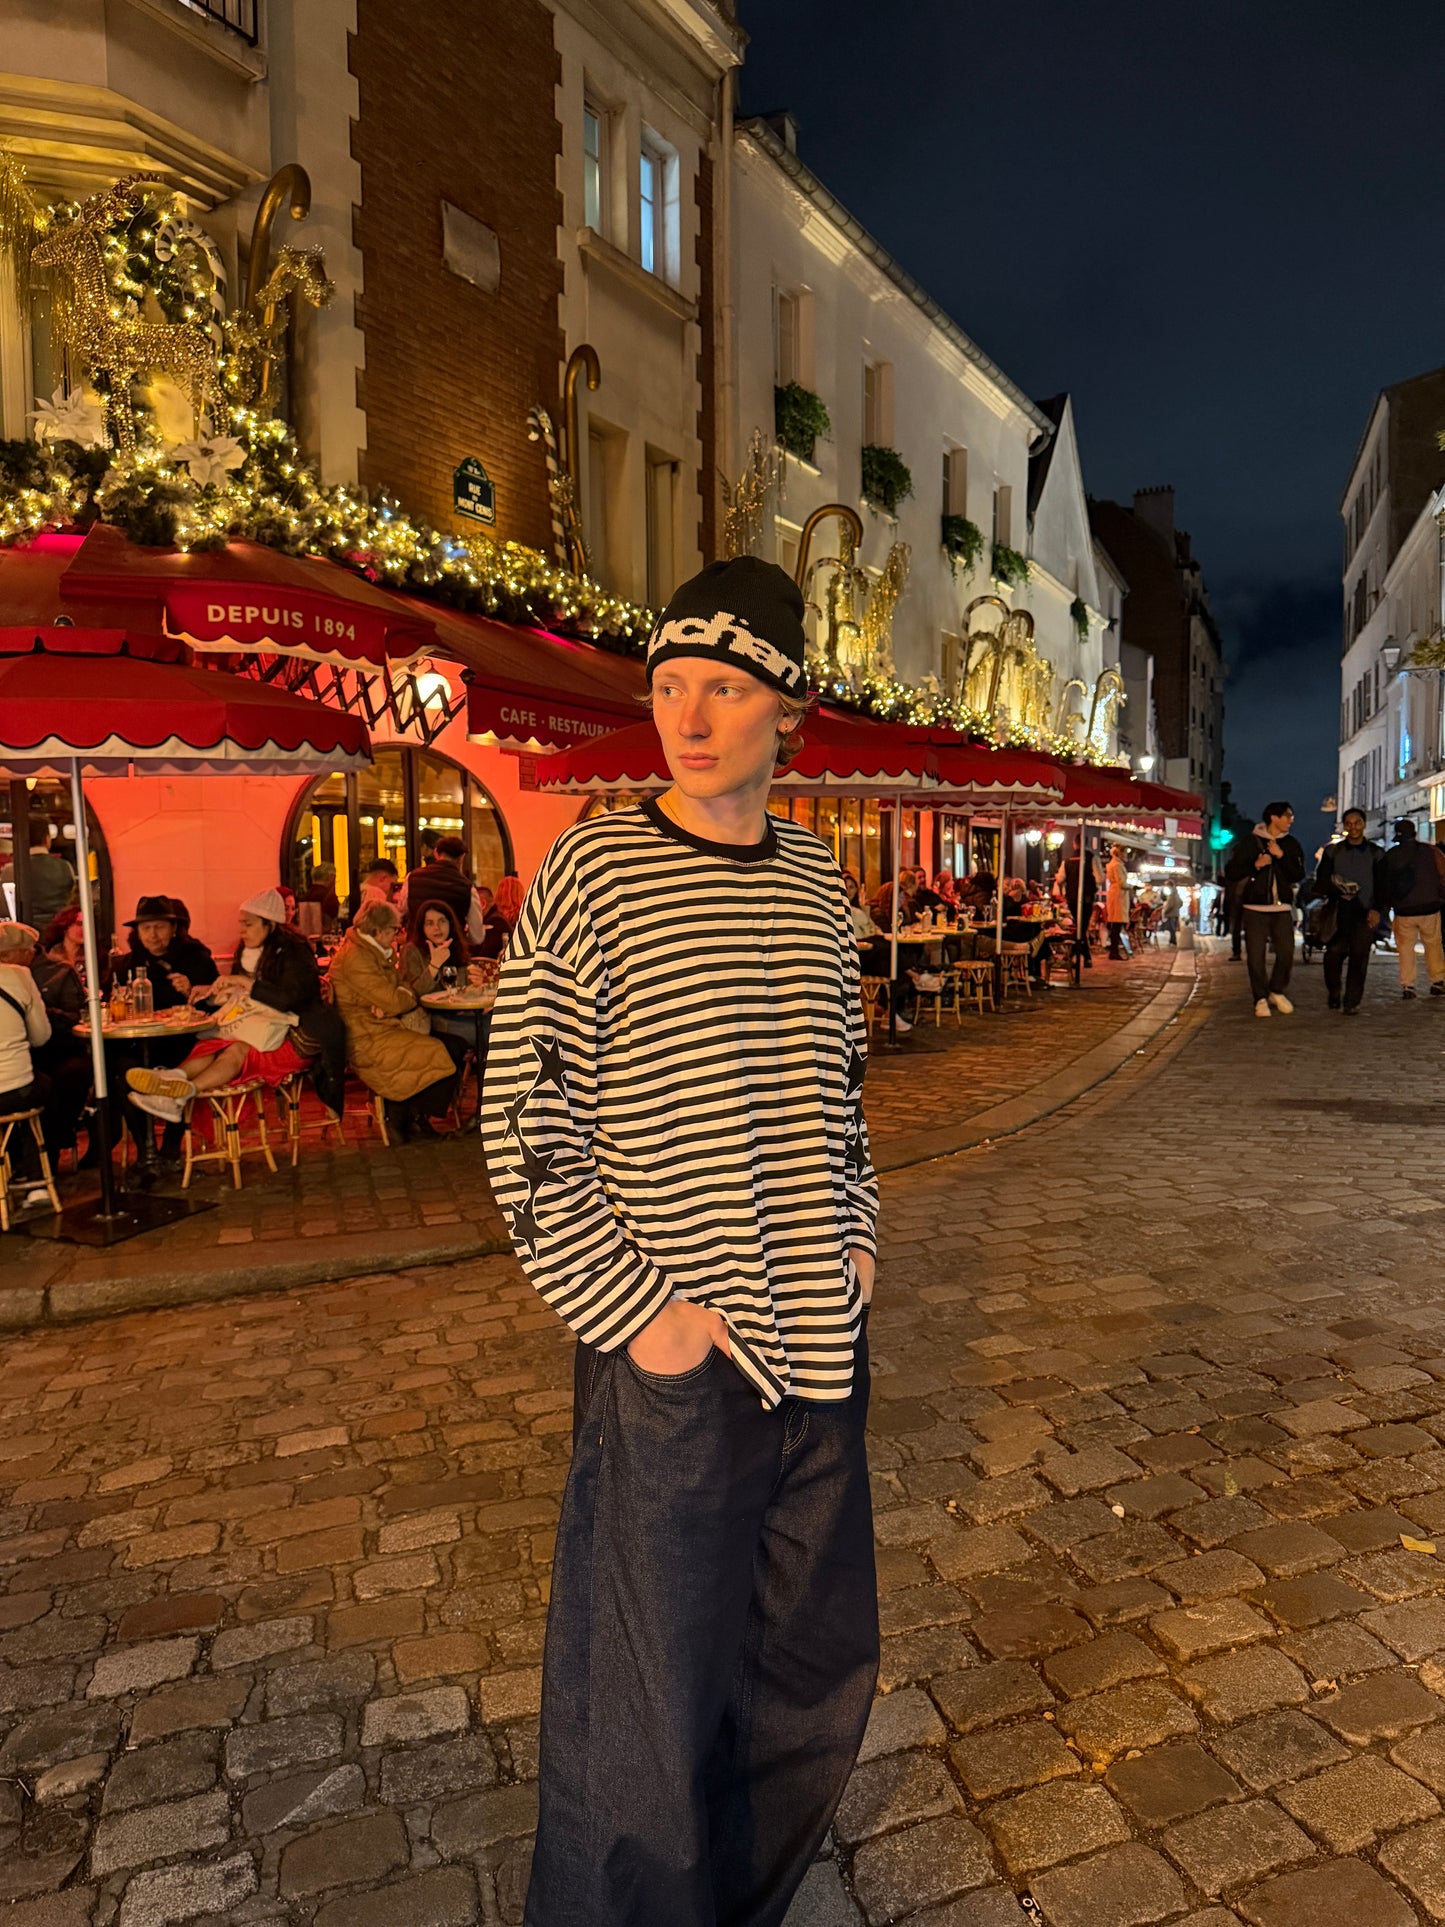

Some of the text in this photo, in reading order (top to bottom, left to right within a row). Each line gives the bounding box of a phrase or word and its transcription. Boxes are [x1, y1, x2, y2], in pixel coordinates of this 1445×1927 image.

[207, 604, 356, 641] DEPUIS 1894
[500, 707, 616, 737] CAFE RESTAURA
